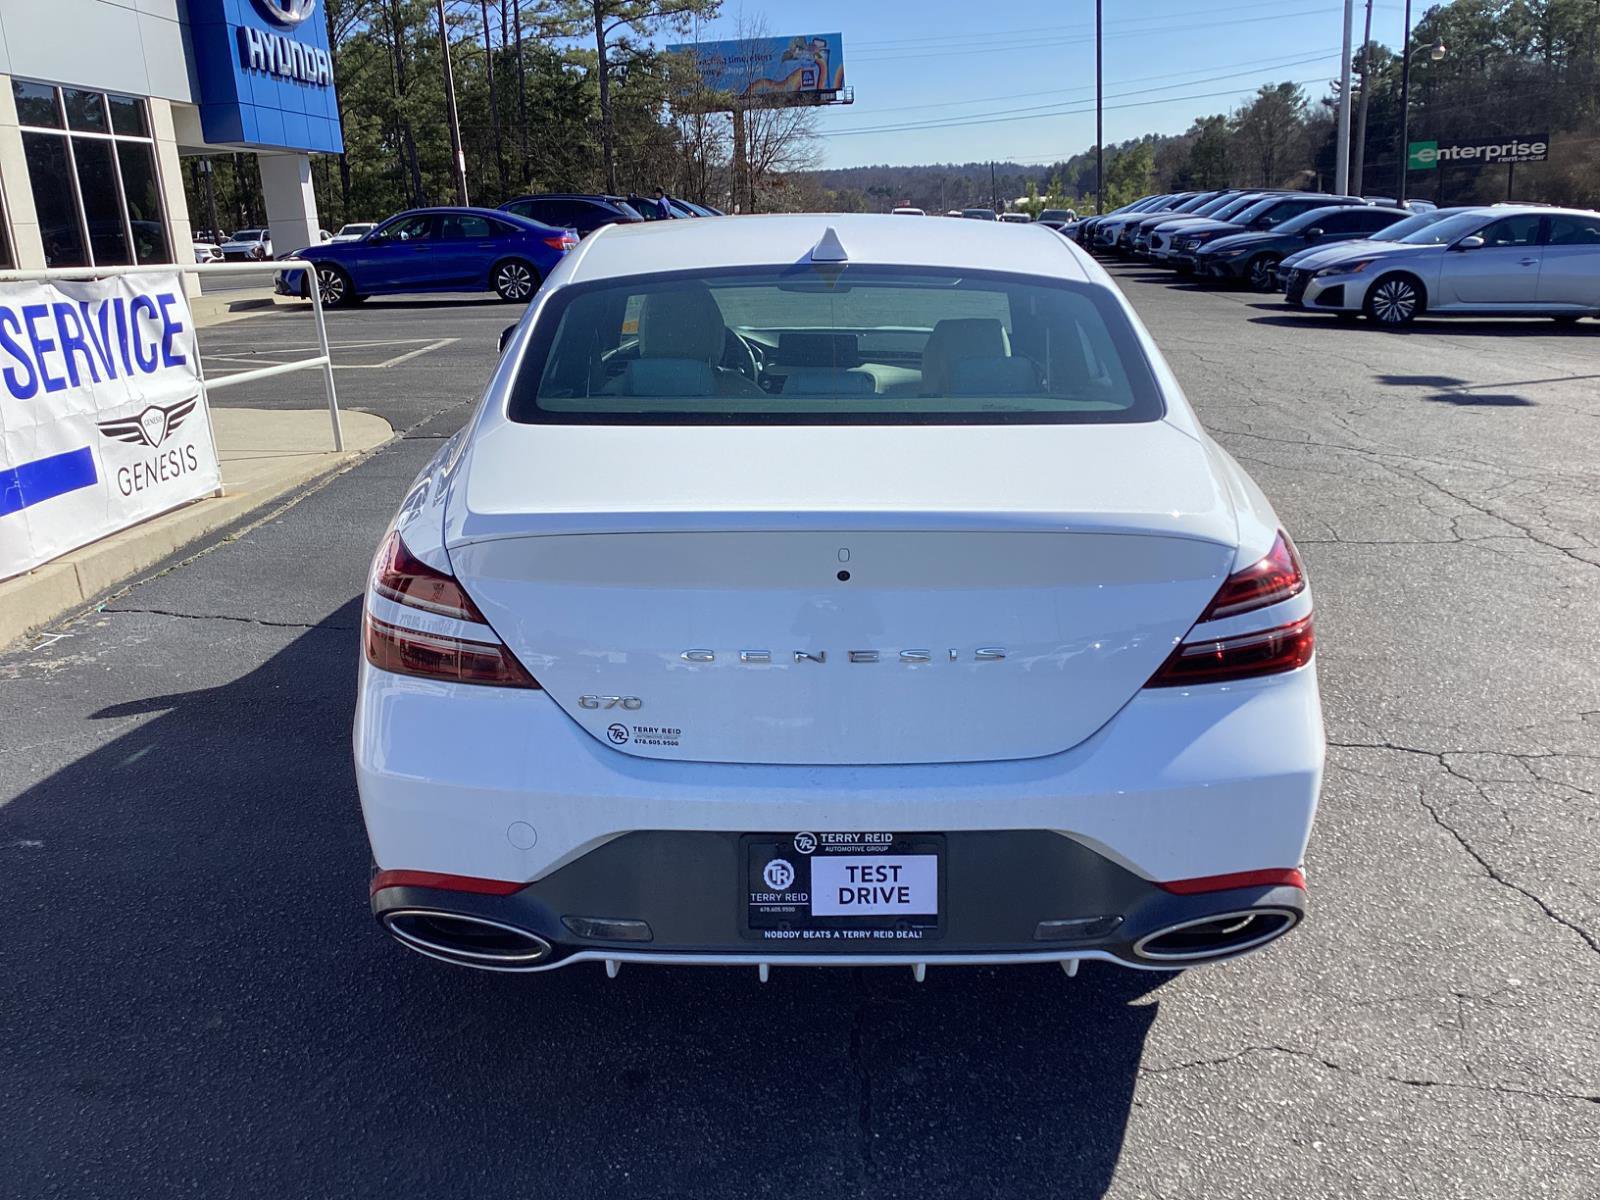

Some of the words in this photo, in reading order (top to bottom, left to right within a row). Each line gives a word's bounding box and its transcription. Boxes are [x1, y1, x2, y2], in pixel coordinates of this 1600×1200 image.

[244, 25, 334, 87] HYUNDAI
[1410, 140, 1547, 163] enterprise
[1498, 154, 1546, 163] rent-a-car
[0, 292, 187, 400] SERVICE
[144, 415, 163, 427] GENESIS
[117, 444, 198, 497] GENESIS
[680, 646, 1007, 664] GENESIS
[578, 695, 642, 710] G70
[820, 833, 860, 843] TERRY
[865, 833, 893, 842] REID
[845, 865, 903, 883] TEST
[751, 893, 782, 902] TERRY
[785, 893, 808, 902] REID
[839, 887, 910, 905] DRIVE
[842, 930, 871, 938] TERRY
[873, 930, 894, 938] REID
[896, 930, 923, 938] DEAL!
